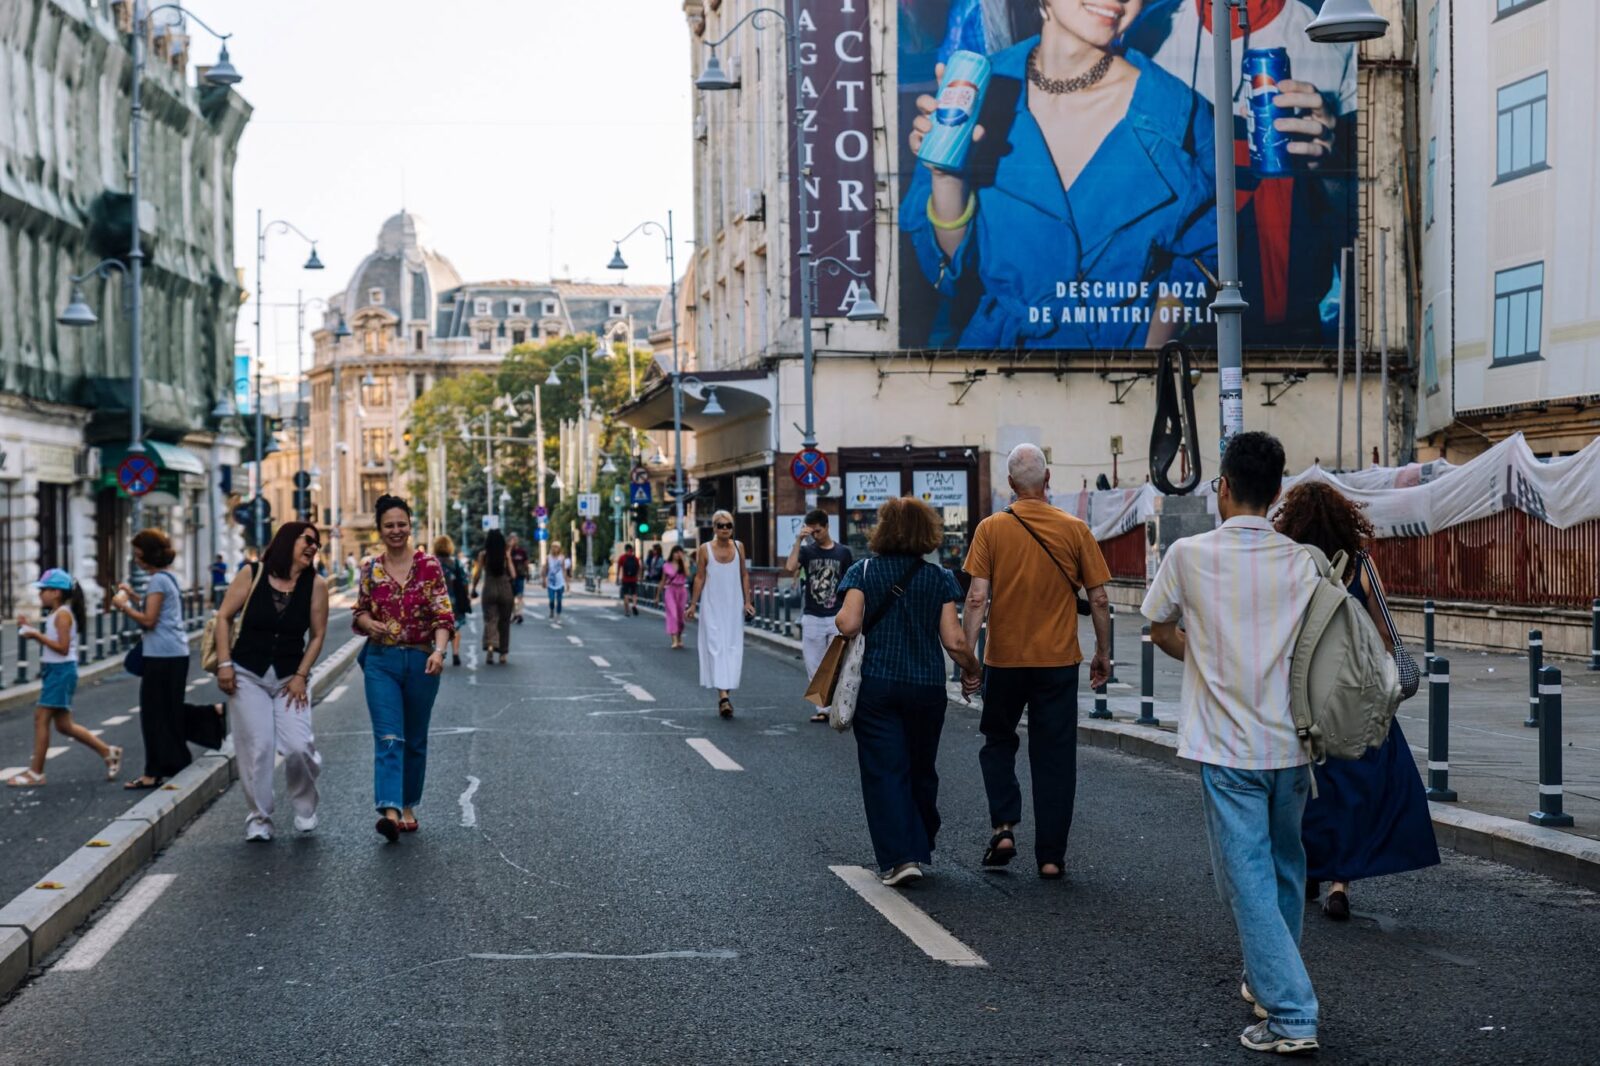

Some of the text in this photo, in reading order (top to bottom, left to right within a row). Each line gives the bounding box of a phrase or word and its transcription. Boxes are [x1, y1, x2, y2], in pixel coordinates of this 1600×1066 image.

[798, 8, 821, 266] AGAZINU
[1055, 281, 1207, 298] DESCHIDE DOZA
[1028, 306, 1218, 323] DE AMINTIRI OFFLI
[859, 473, 888, 488] PAM
[925, 472, 955, 486] PAM
